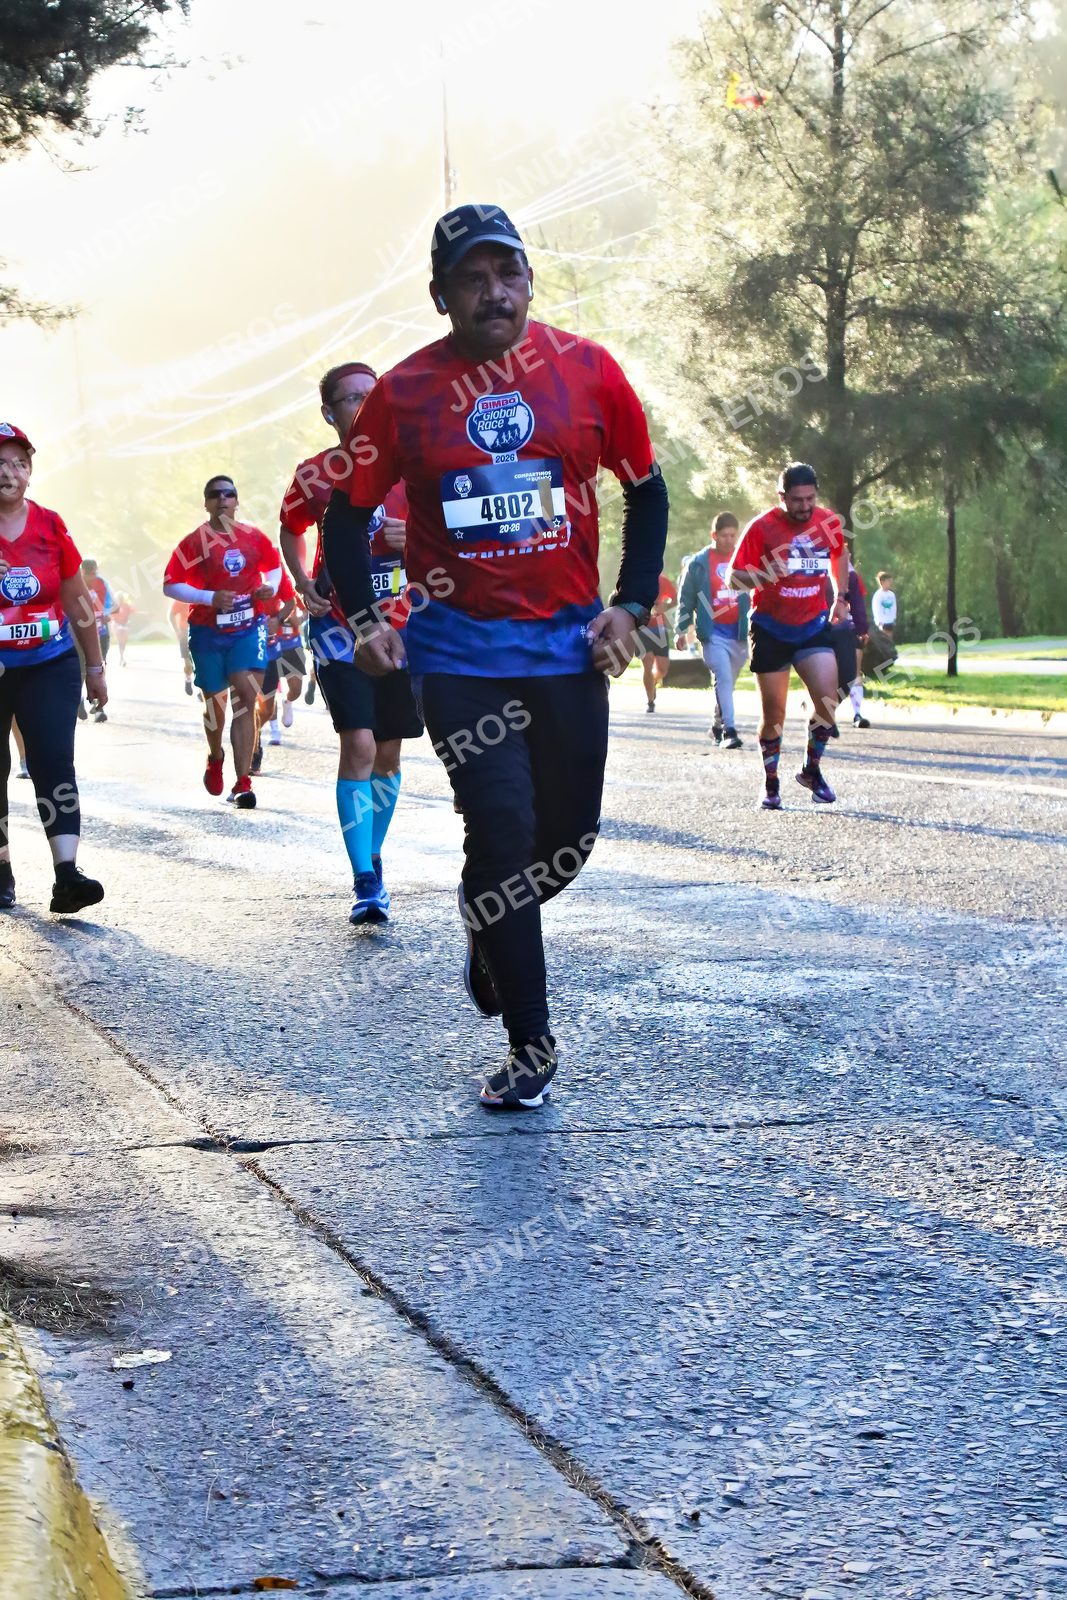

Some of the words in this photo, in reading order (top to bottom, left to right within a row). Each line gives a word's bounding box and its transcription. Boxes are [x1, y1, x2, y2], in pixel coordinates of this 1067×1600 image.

[481, 398, 516, 410] BIMBO
[482, 406, 517, 421] Global
[477, 418, 505, 431] Race
[495, 454, 515, 464] 2026
[481, 492, 535, 522] 4802
[542, 530, 558, 539] 10K
[800, 559, 819, 569] 5105
[229, 611, 246, 623] 4520
[10, 623, 38, 639] 1570
